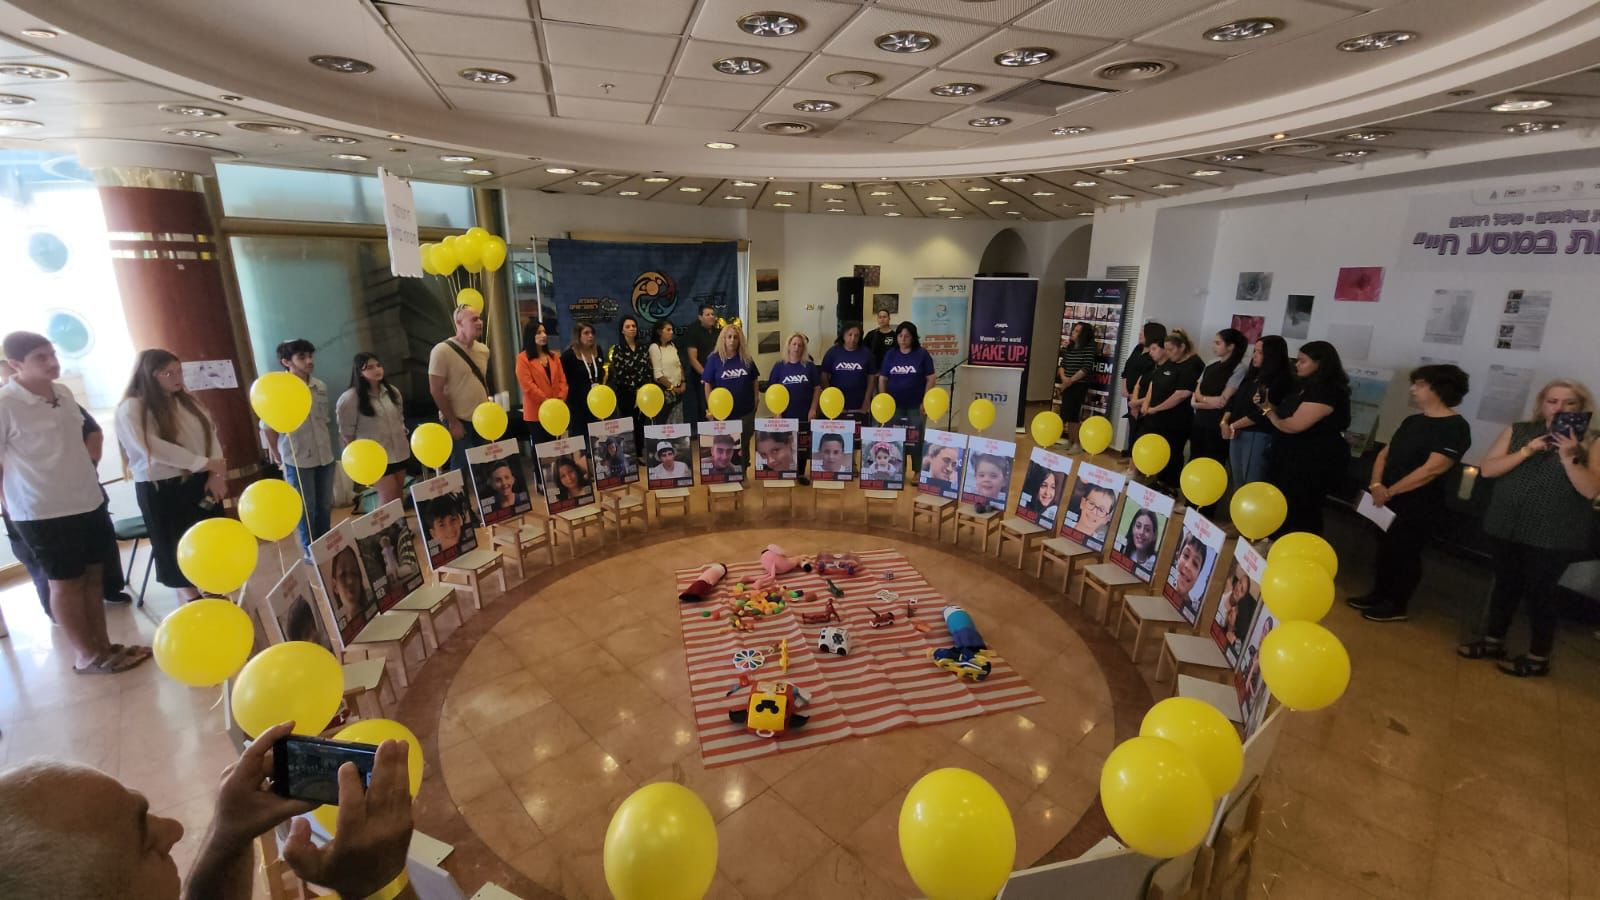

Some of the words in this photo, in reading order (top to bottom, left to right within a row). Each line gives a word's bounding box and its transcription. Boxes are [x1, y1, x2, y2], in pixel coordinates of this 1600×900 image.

[1467, 229, 1557, 255] במסע
[971, 343, 1006, 361] WAKE
[1008, 345, 1028, 362] UP!
[1092, 361, 1113, 374] HEM
